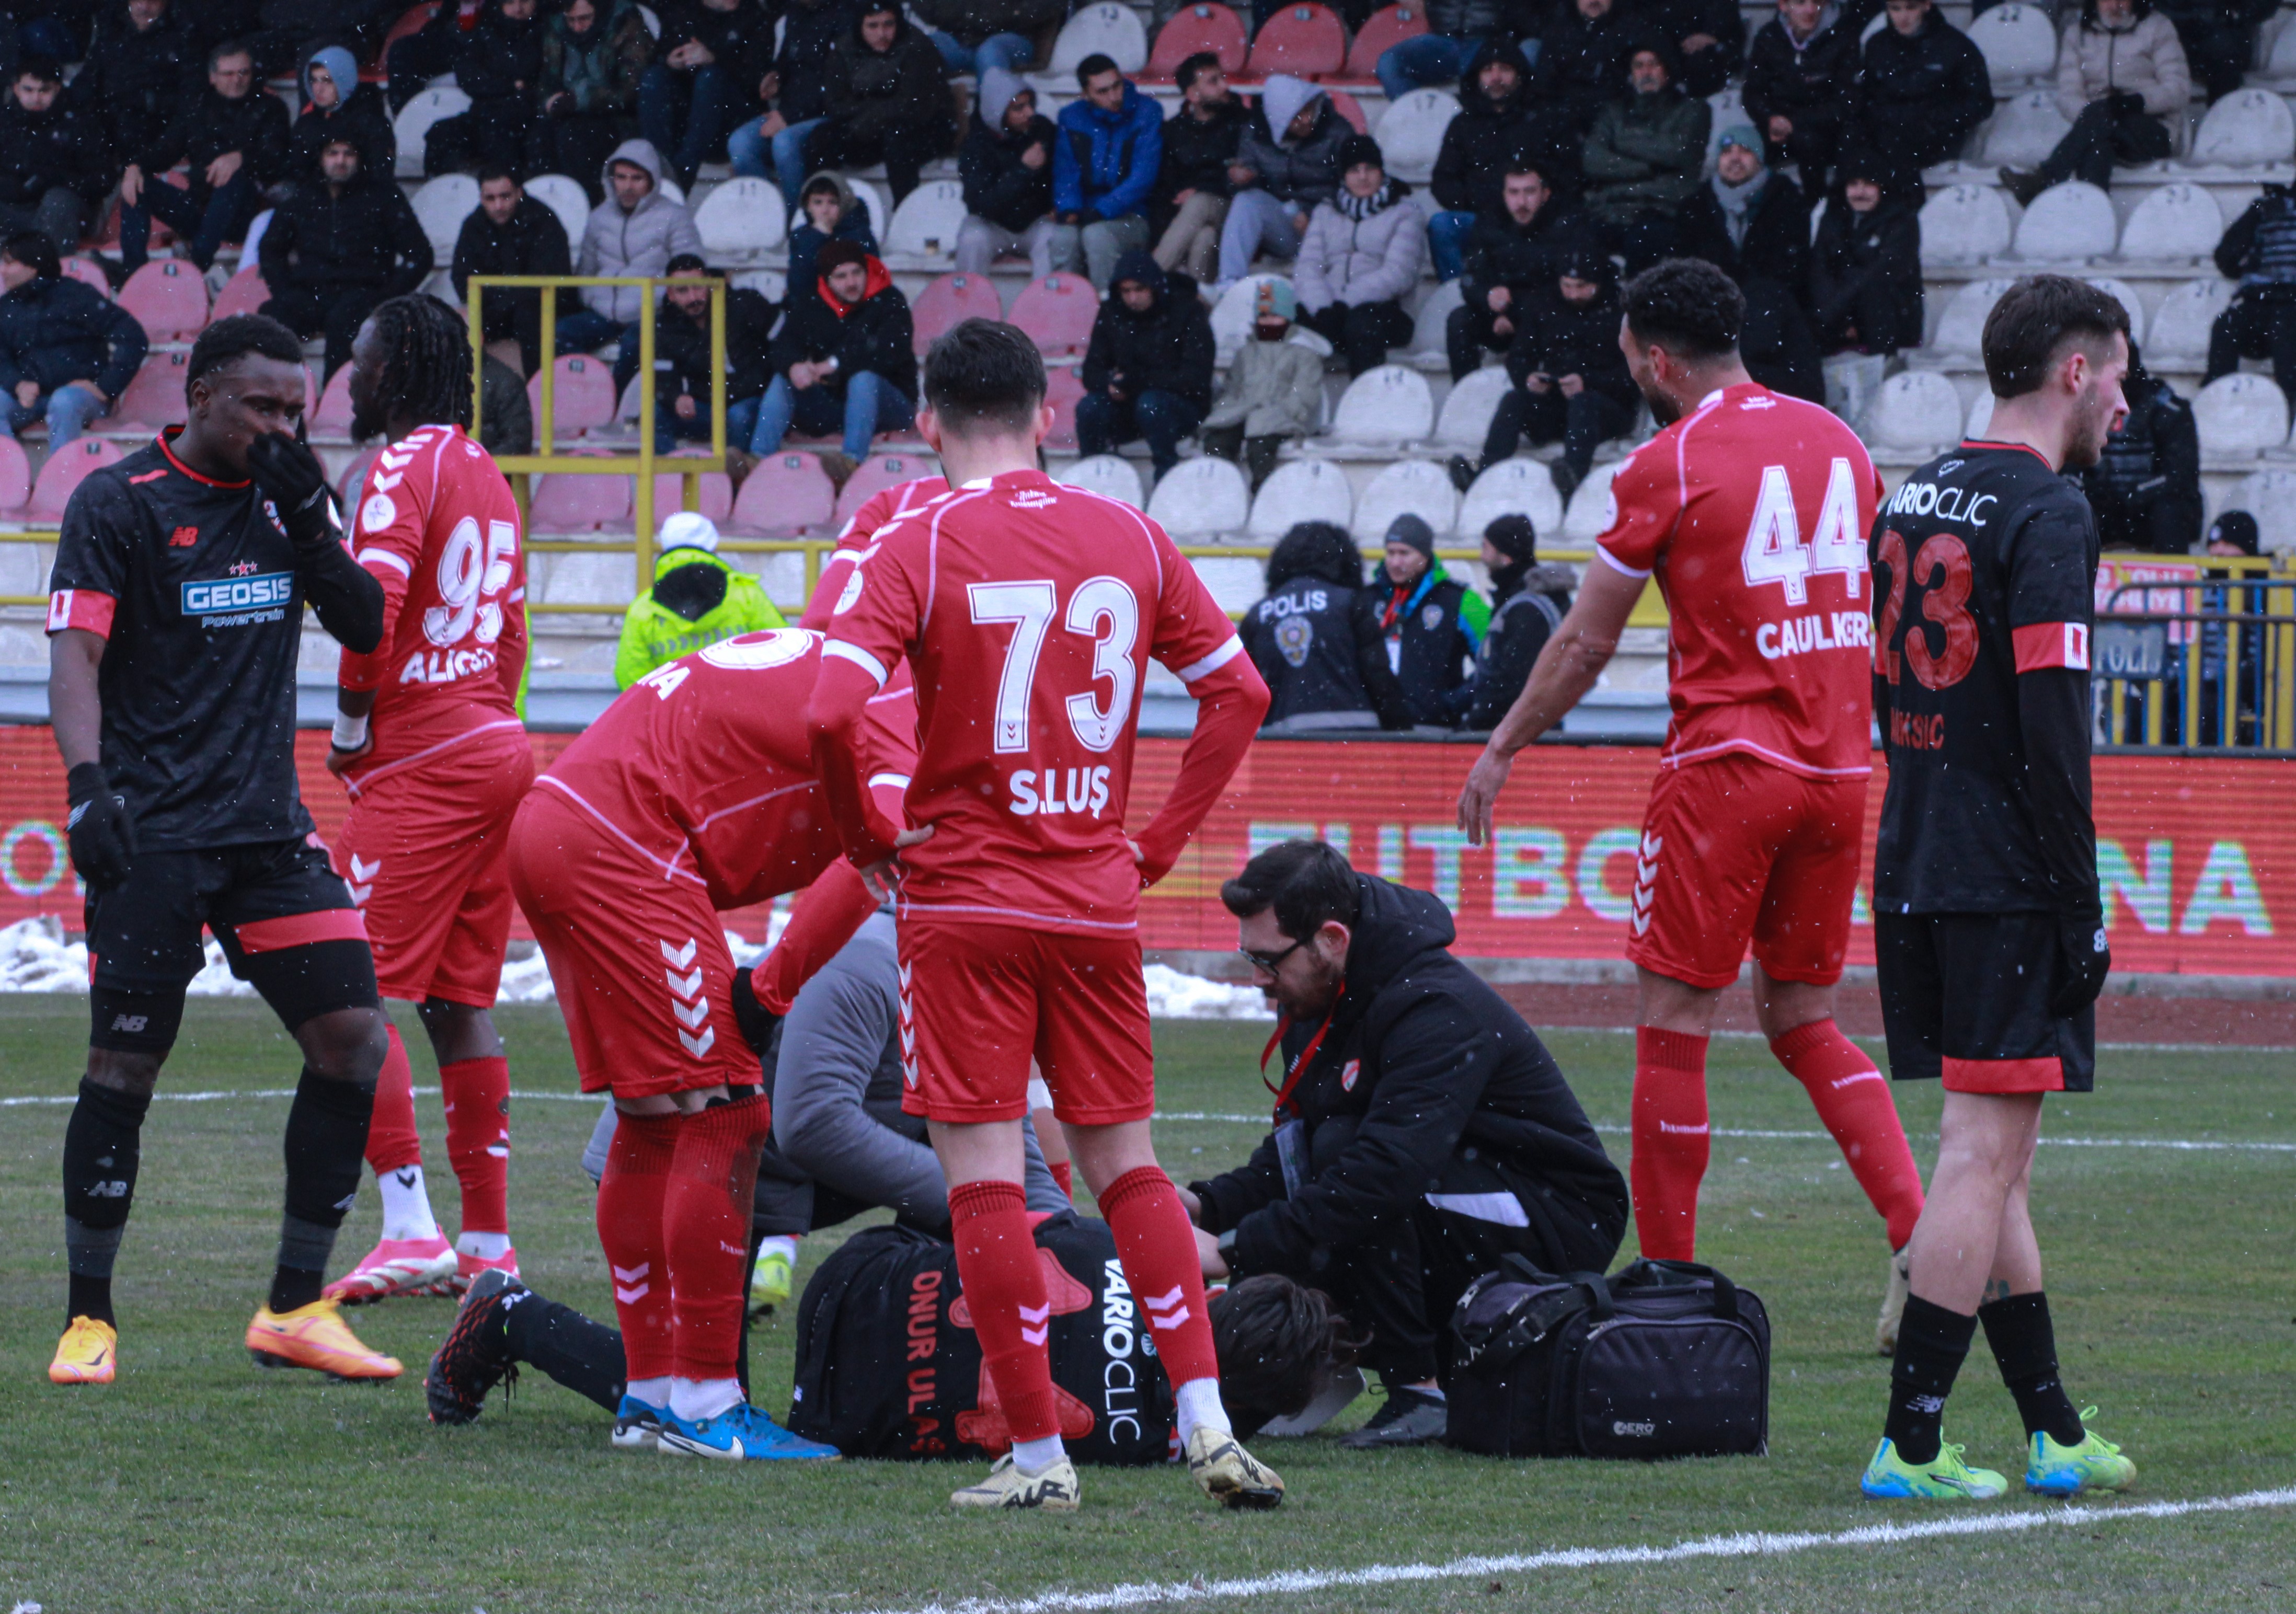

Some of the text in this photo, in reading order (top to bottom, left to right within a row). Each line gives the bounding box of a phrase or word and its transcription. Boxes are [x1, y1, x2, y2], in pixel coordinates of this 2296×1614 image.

[422, 515, 516, 647] 95
[1741, 457, 1869, 606] 44
[187, 577, 291, 610] GEOSIS
[1259, 589, 1328, 624] POLIS
[966, 575, 1139, 754] 73
[907, 1270, 943, 1362] ONUR
